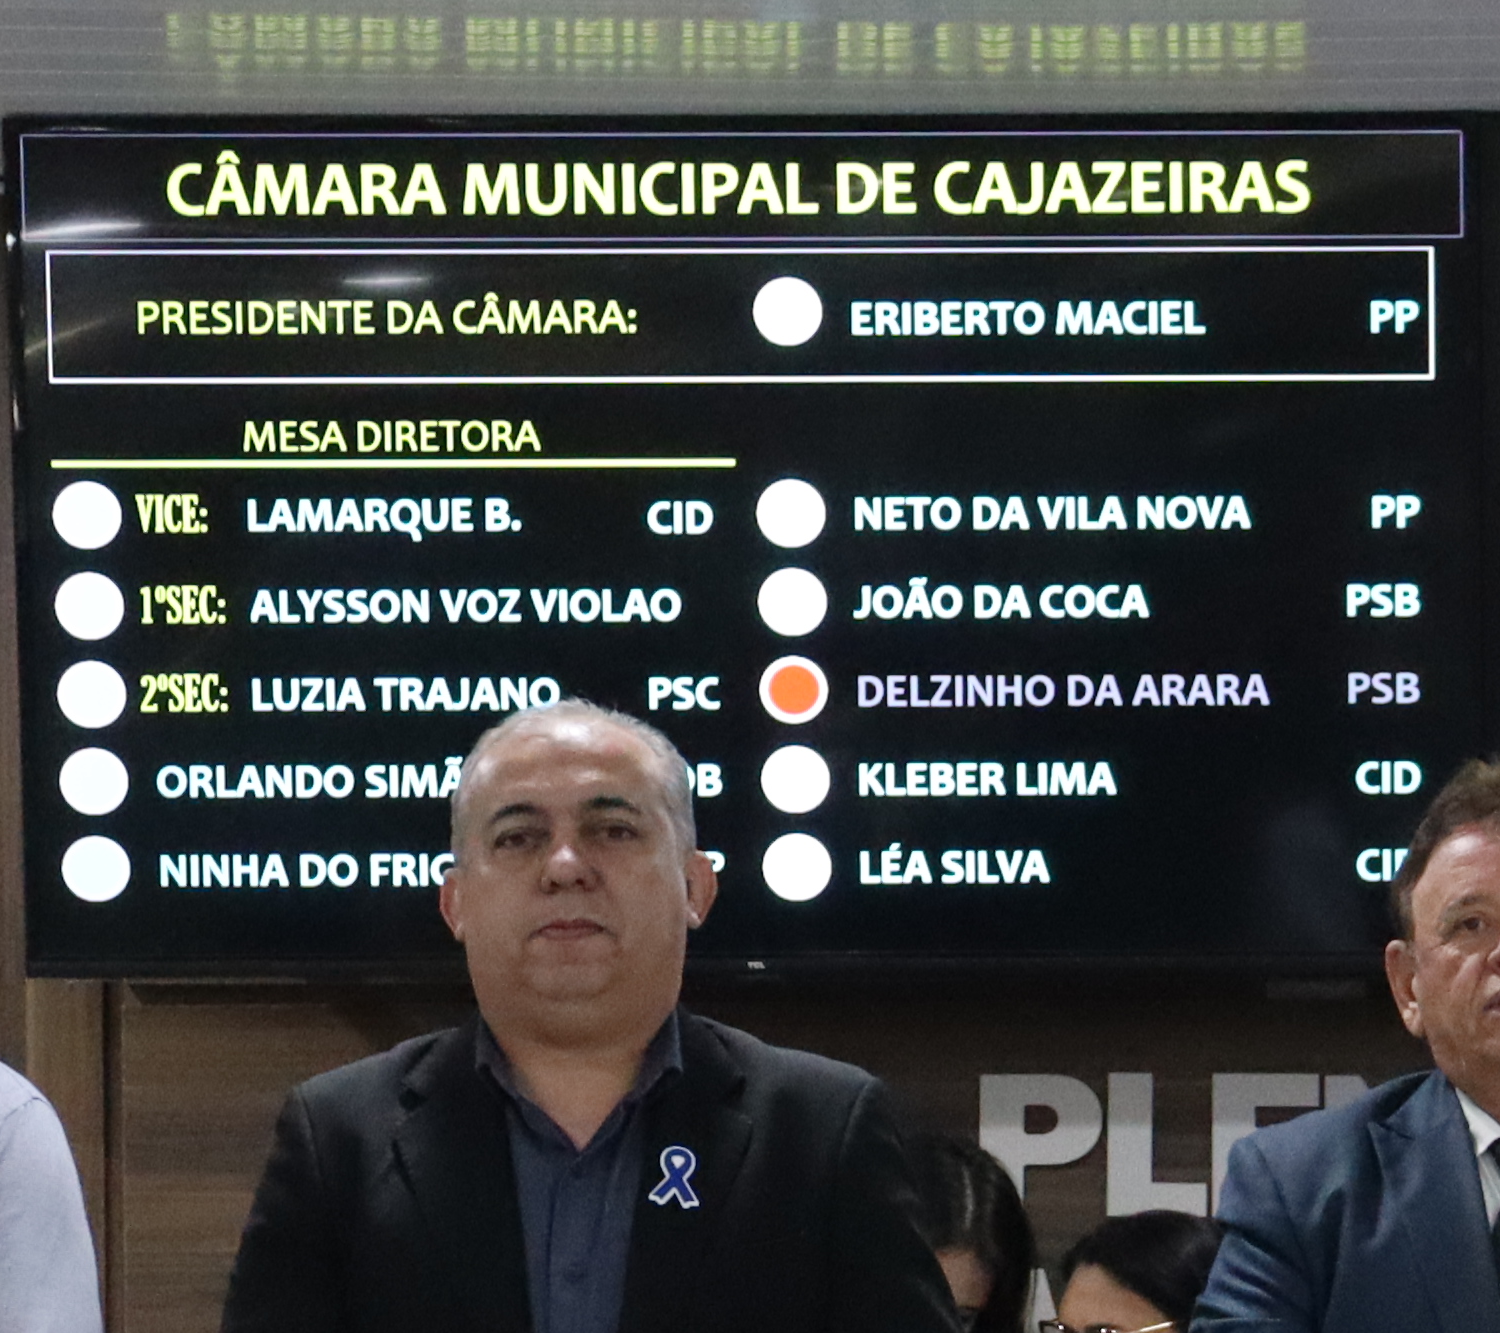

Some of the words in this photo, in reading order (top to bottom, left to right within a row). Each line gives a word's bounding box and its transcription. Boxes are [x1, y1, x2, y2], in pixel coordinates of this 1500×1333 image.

[167, 150, 446, 216] CÂMARA
[463, 162, 819, 216] MUNICIPAL
[836, 162, 917, 214] DE
[934, 160, 1311, 215] CAJAZEIRAS
[137, 300, 376, 335] PRESIDENTE
[386, 300, 445, 335] DA
[452, 292, 638, 335] CÂMARA:
[850, 301, 1046, 336] ERIBERTO
[1055, 301, 1206, 336] MACIEL
[1370, 300, 1419, 334] PP
[243, 421, 348, 452] MESA
[356, 420, 542, 453] DIRETORA
[135, 494, 208, 534] VICE:
[247, 498, 475, 542] LAMARQUE
[485, 498, 522, 533] B.
[647, 501, 713, 535] CID
[854, 496, 963, 530] NETO
[972, 496, 1031, 530] DA
[1036, 496, 1128, 530] VILA
[1136, 495, 1252, 530] NOVA
[1371, 495, 1421, 530] PP
[250, 589, 431, 624] ALYSSON
[440, 589, 523, 623] VOZ
[529, 588, 683, 623] VIOLAO
[853, 577, 964, 619] JOÃO
[973, 584, 1032, 619] DA
[1038, 584, 1150, 619] COCA
[1347, 583, 1422, 618] PSB
[252, 677, 367, 712] LUZIA
[372, 677, 561, 712] TRAJANO
[649, 677, 721, 711] PSC
[858, 674, 1056, 708] DELZINHO
[1066, 674, 1124, 707] DA
[1131, 674, 1271, 707] ARARA
[1347, 672, 1421, 705] PSB
[156, 765, 355, 799] ORLANDO
[858, 762, 1007, 797] KLEBER
[1016, 762, 1118, 796] LIMA
[1355, 761, 1423, 795] CID
[159, 854, 290, 888] NINHA
[299, 853, 359, 888] DO
[860, 842, 933, 885] LÉA
[940, 850, 1051, 885] SILVA
